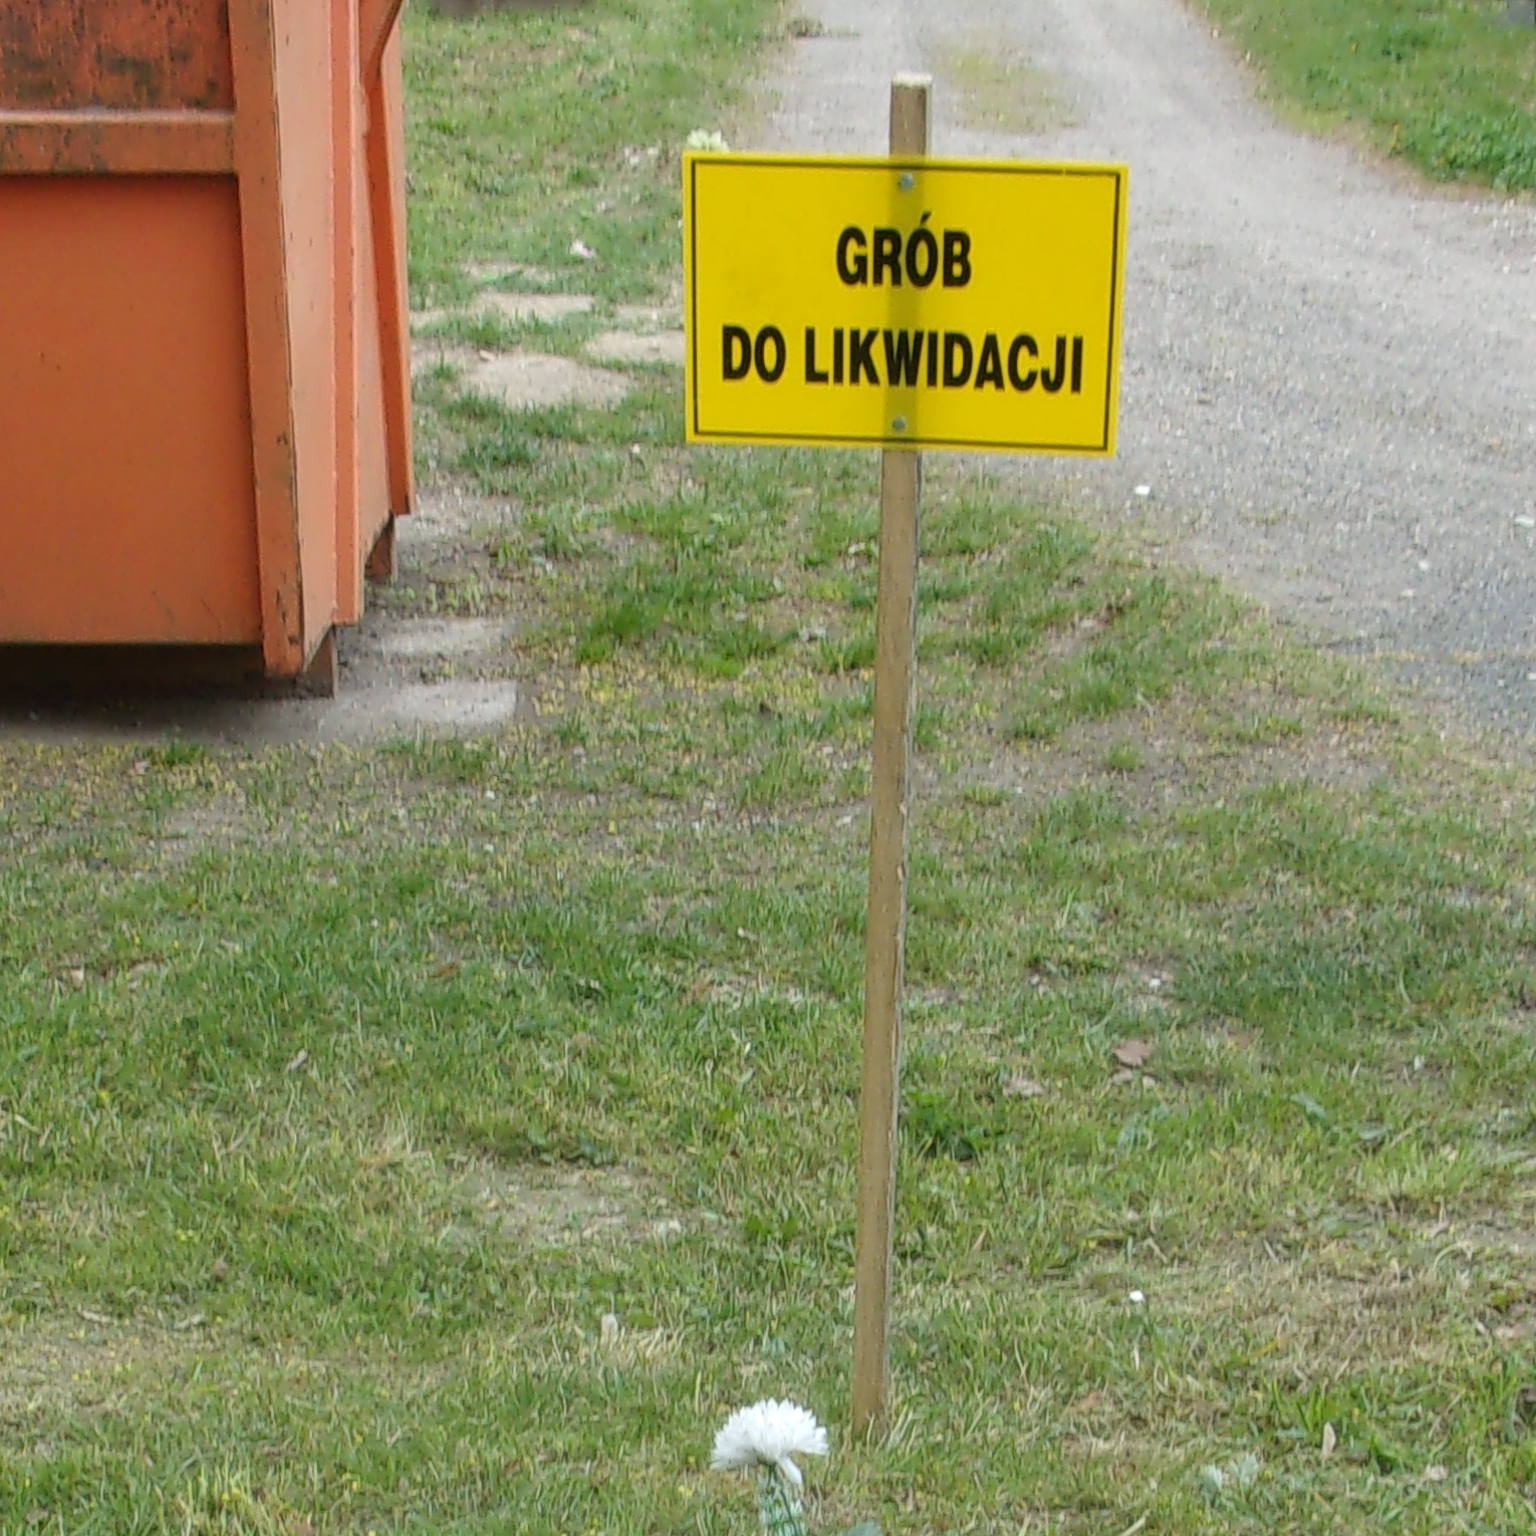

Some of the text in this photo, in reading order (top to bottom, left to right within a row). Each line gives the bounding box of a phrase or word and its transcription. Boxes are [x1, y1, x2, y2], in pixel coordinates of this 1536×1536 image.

[835, 211, 972, 288] GRÓB
[721, 325, 1085, 394] DO LIKWIDACJI
